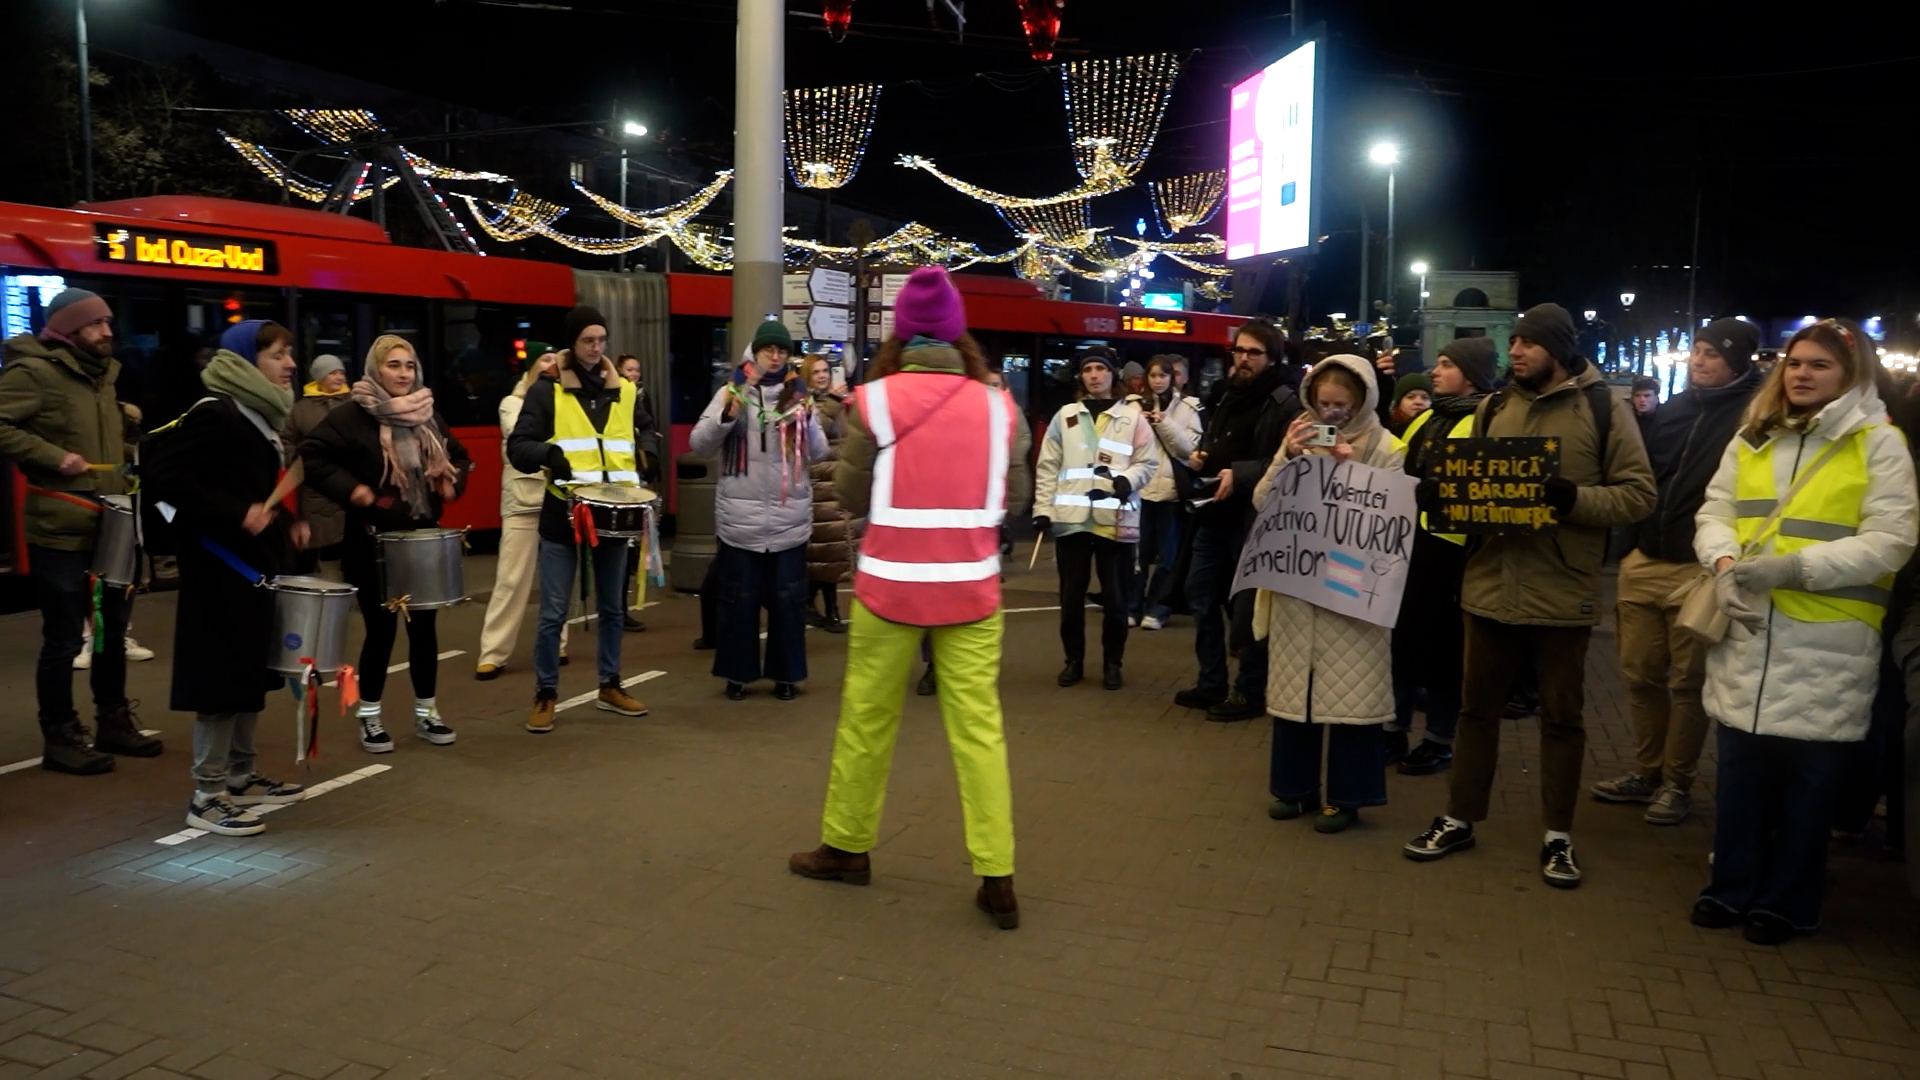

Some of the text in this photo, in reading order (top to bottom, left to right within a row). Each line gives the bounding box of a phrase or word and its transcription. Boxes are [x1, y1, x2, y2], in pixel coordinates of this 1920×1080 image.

[1445, 458, 1483, 477] MI-E
[1439, 482, 1458, 499] DE
[1450, 504, 1470, 521] NU
[1323, 502, 1411, 560] TUTUROR
